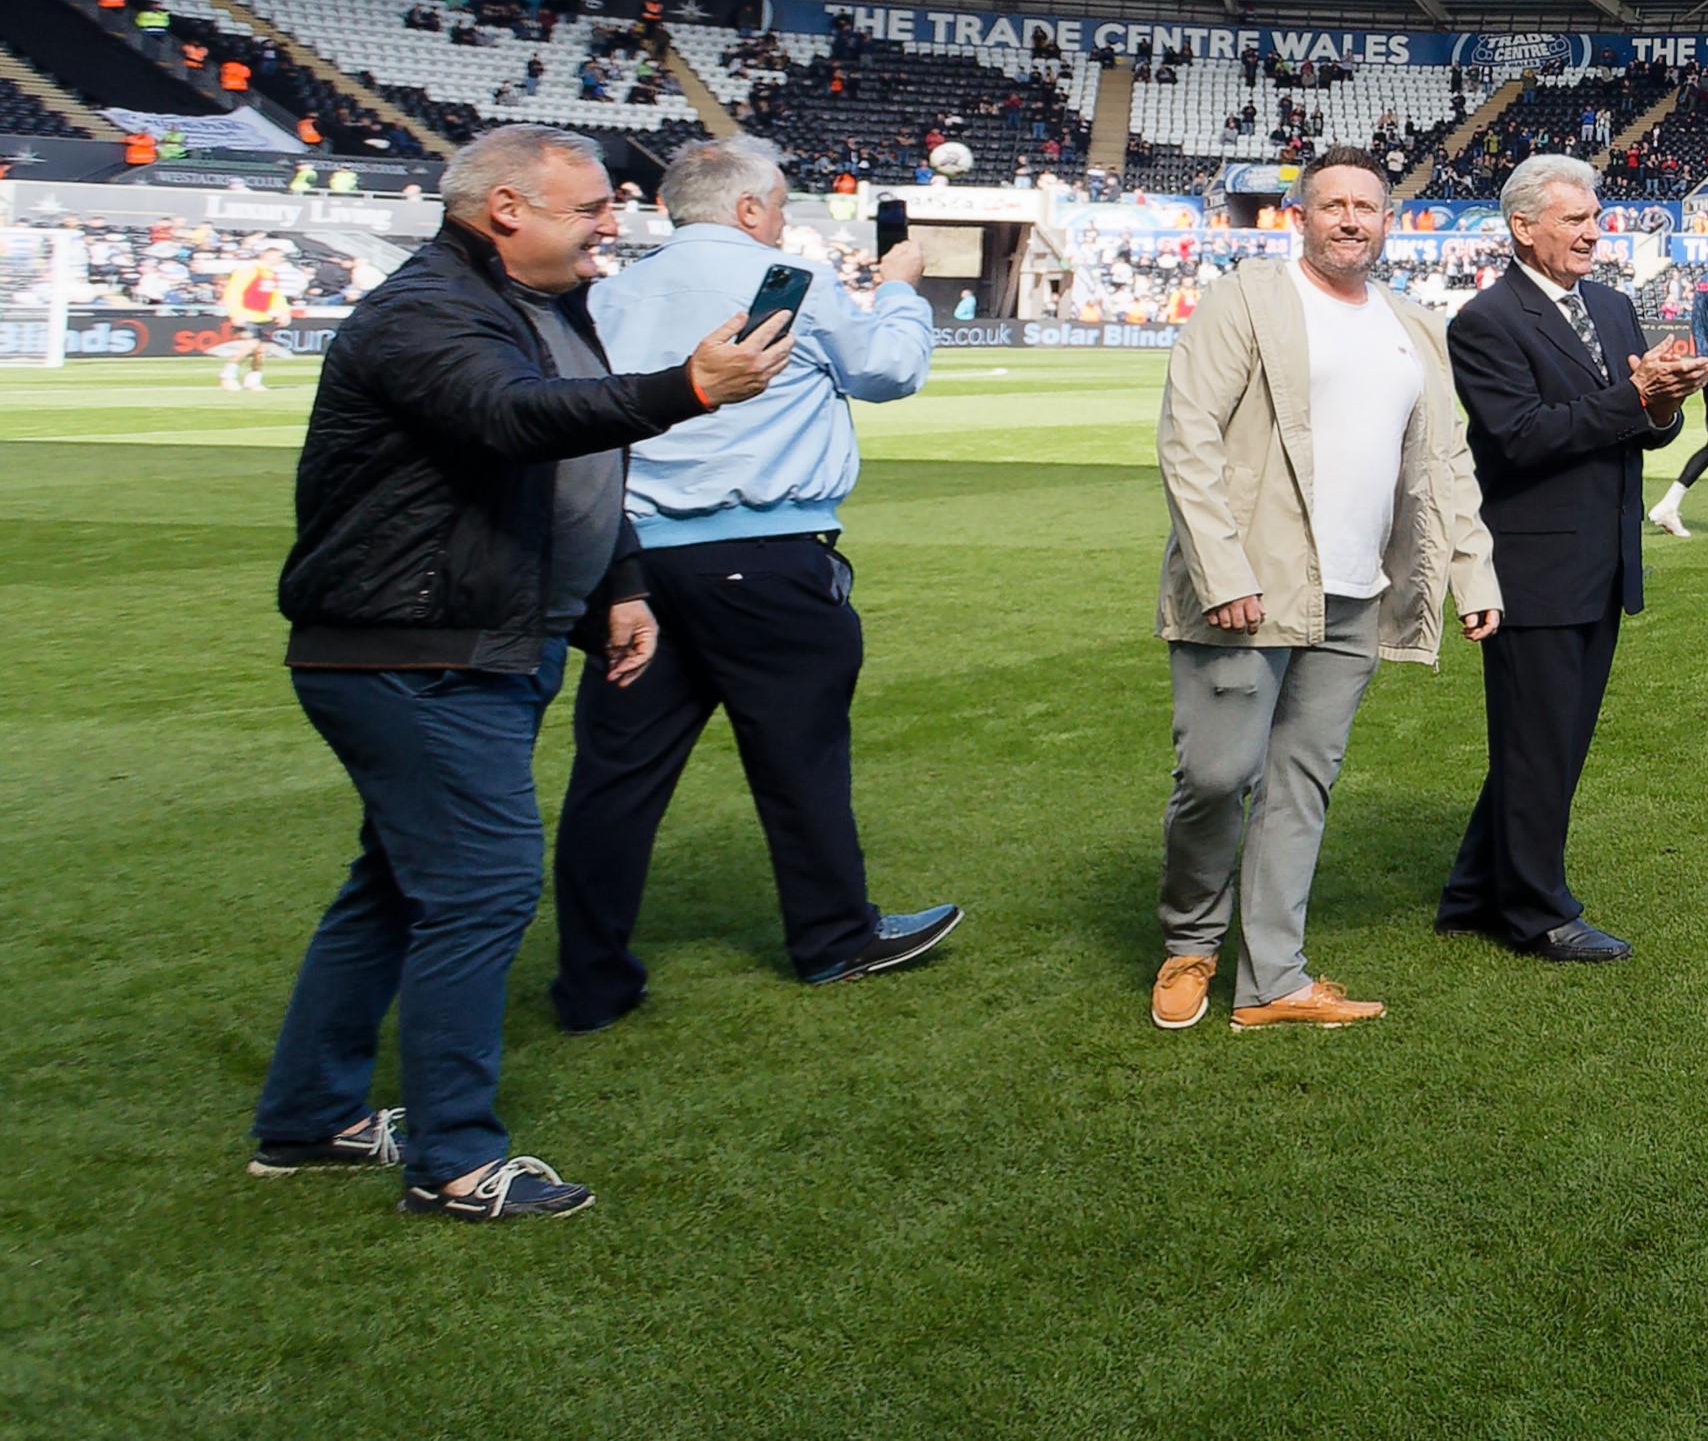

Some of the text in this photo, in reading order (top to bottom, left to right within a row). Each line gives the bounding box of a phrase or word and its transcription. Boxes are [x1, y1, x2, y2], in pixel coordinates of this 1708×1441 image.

[927, 12, 1082, 50] TRADE
[1095, 22, 1260, 58] CENTRE
[1271, 31, 1410, 64] WALES
[1485, 33, 1556, 47] TRADE
[1493, 43, 1552, 62] CENTRE
[1632, 37, 1697, 66] THE
[206, 195, 392, 232] Luxury Living
[1023, 323, 1100, 347] Solar
